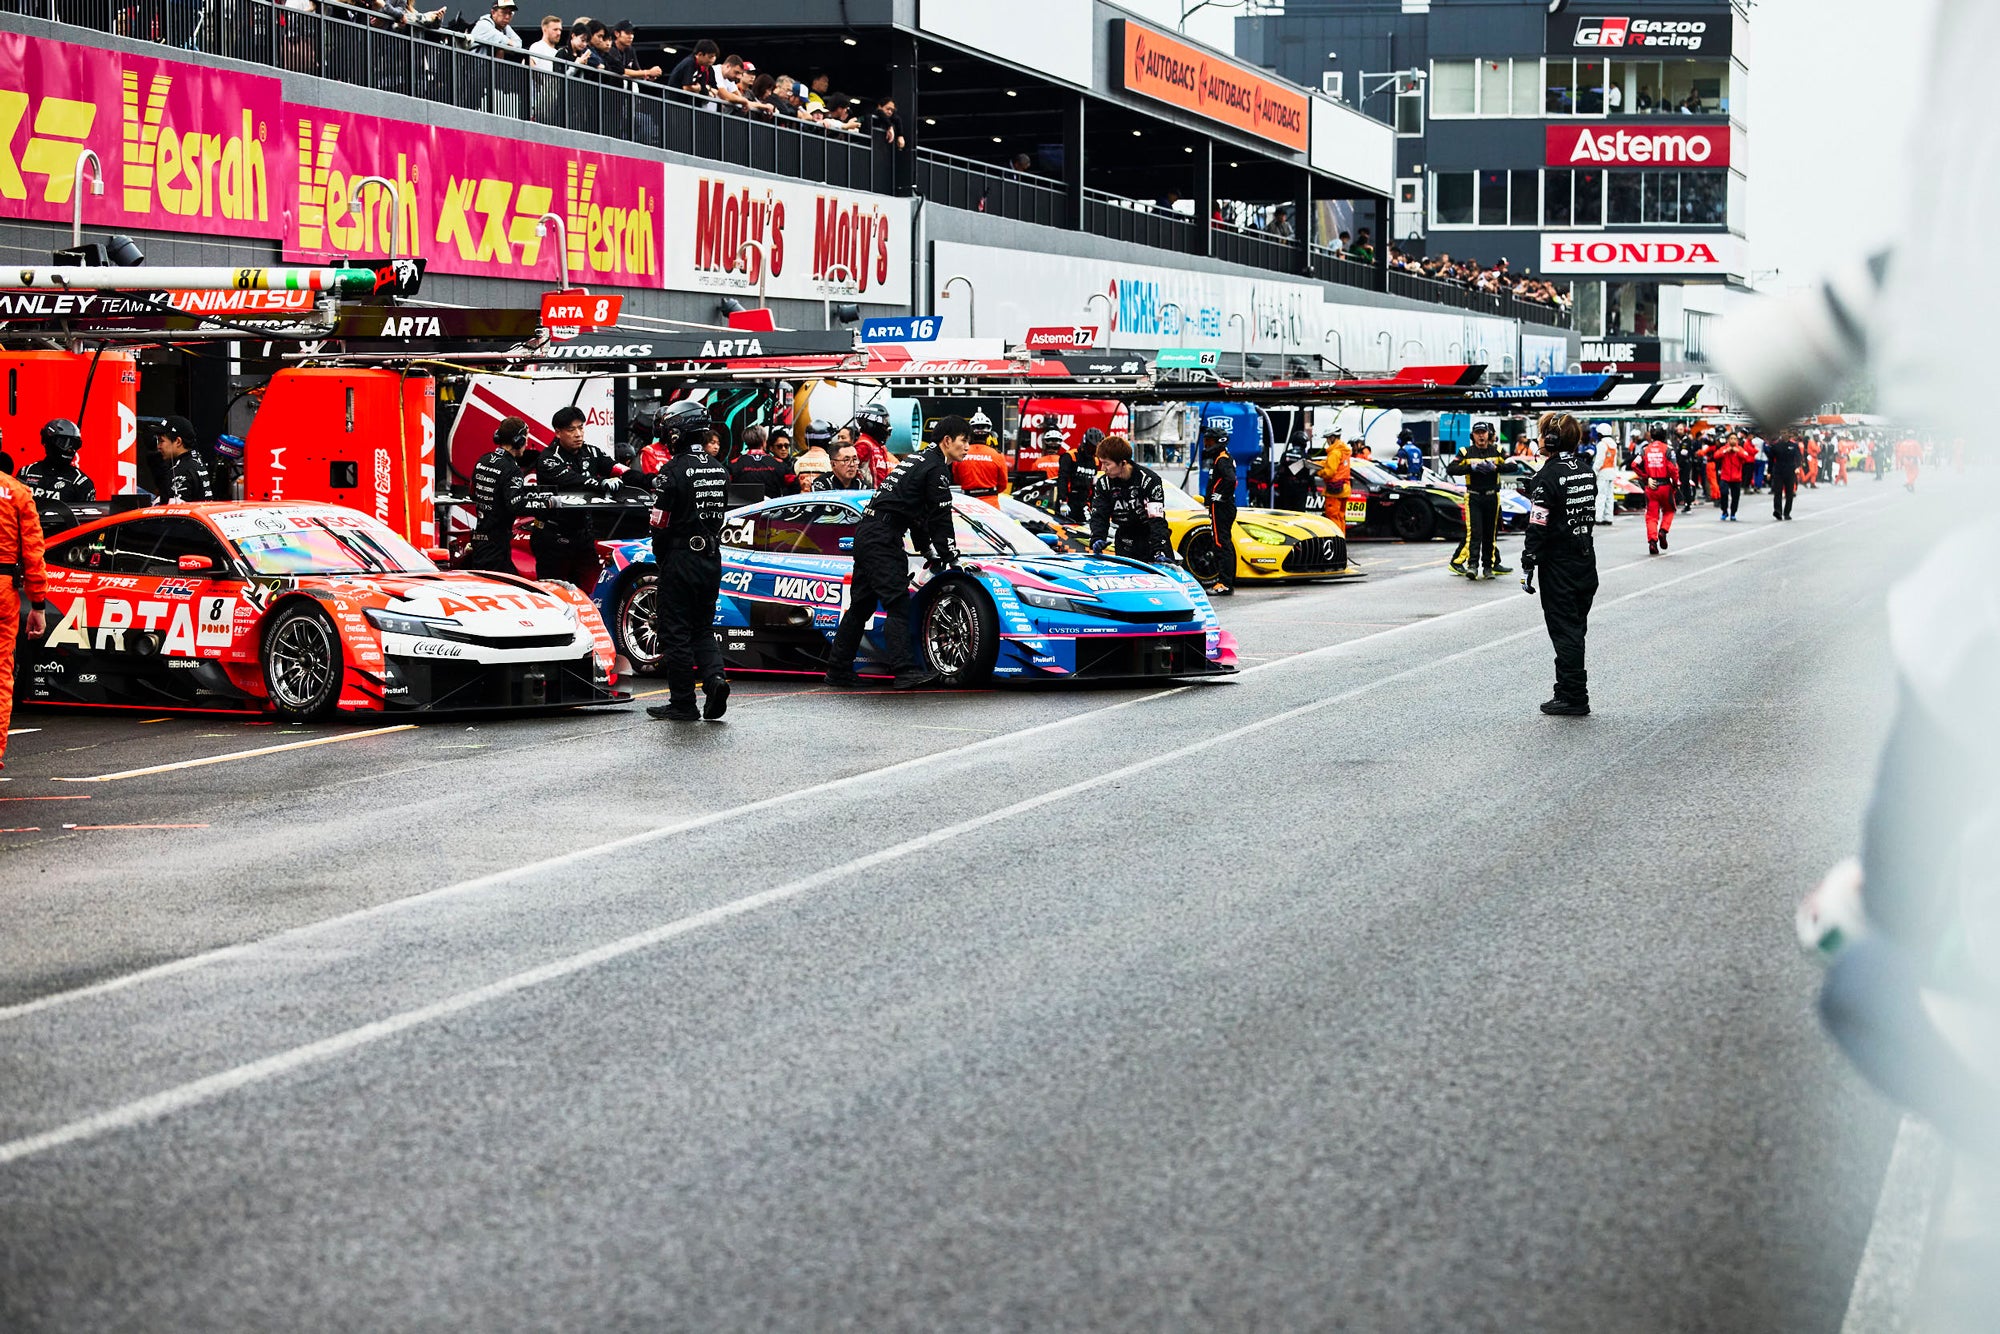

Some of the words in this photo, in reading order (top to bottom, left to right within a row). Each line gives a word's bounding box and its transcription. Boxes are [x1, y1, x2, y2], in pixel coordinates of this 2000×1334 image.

[1576, 28, 1624, 45] GR
[1628, 34, 1702, 50] Racing
[1145, 49, 1195, 92] AUTOBACS
[1208, 75, 1251, 113] AUTOBACS
[1262, 98, 1301, 133] AUTOBACS
[123, 70, 268, 222] Vesrah
[1570, 128, 1711, 163] Astemo
[299, 119, 420, 257] Vesrah
[567, 160, 655, 276] Vesrah
[695, 176, 786, 286] Moty's
[813, 194, 889, 294] Moty's
[1551, 242, 1720, 263] HONDA
[238, 269, 262, 289] 87
[101, 299, 144, 313] TEAM
[146, 290, 308, 312] KUNIMITSU
[548, 306, 584, 318] ARTA
[594, 299, 609, 322] 8
[380, 317, 442, 337] ARTA
[867, 326, 904, 338] ARTA
[910, 319, 934, 339] 16
[700, 338, 763, 358] ARTA
[1030, 332, 1073, 345] Astemo
[1074, 331, 1091, 345] 17
[899, 360, 988, 373] Modulo
[1201, 354, 1215, 364] 64
[1497, 388, 1549, 398] RADIATOR
[1019, 414, 1077, 429] MOUL
[1212, 418, 1230, 428] TRS
[1346, 501, 1365, 512] 360
[287, 516, 374, 529] BOSCH
[47, 586, 84, 594] Honda
[155, 577, 203, 595] HRC
[721, 571, 753, 593] 4CR
[773, 575, 841, 604] WAKO'S
[209, 598, 224, 621] 8
[438, 594, 561, 617] ARTA
[44, 597, 196, 656] ARTA
[201, 624, 230, 634] PONOS
[738, 629, 754, 637] Holts
[34, 661, 64, 673] amon
[180, 660, 200, 669] Holts
